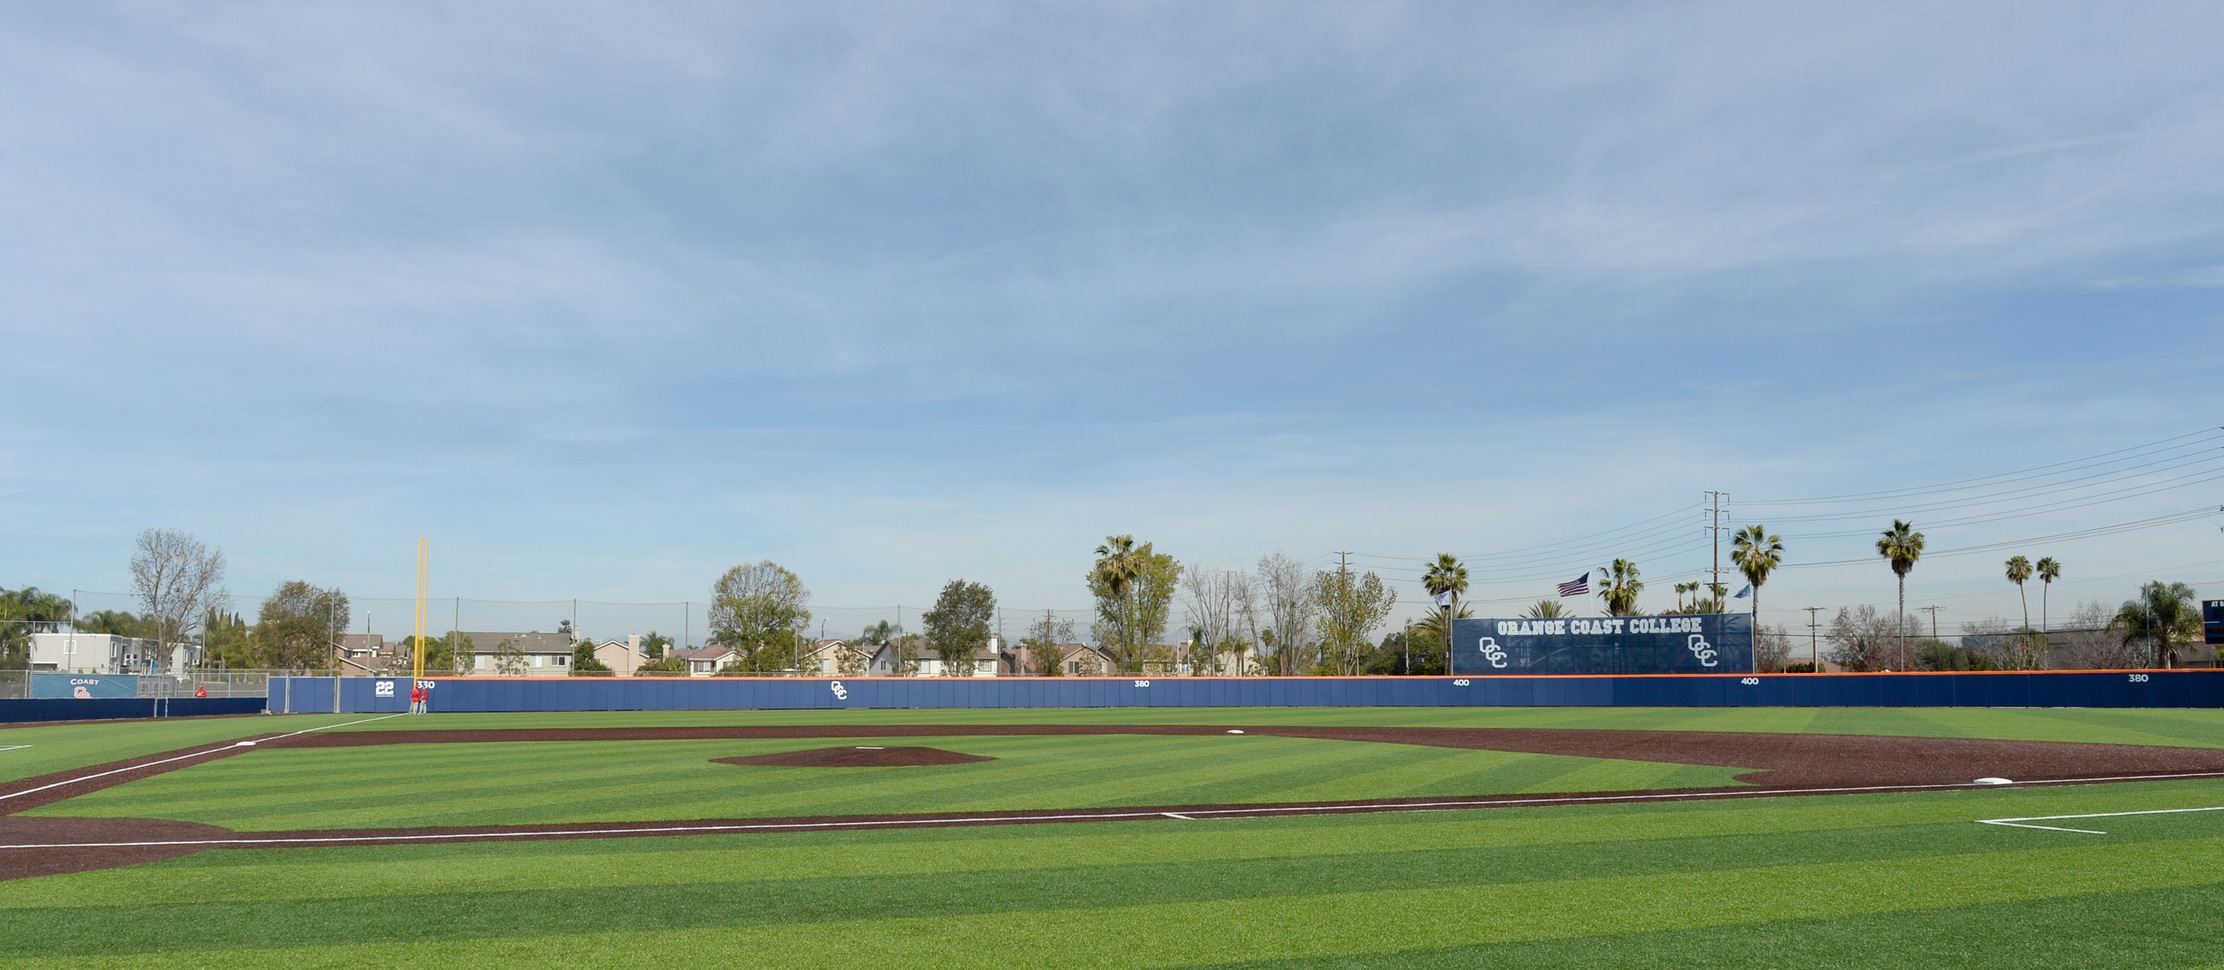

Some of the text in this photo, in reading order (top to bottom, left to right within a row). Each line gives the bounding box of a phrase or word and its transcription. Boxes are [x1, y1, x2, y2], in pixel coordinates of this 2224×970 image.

[1497, 617, 1702, 636] ORANGE COAST COLLEGE
[1479, 636, 1508, 668] OCC
[1687, 633, 1718, 667] OCC
[1134, 680, 1150, 688] 380
[1452, 678, 1470, 687] 400
[1740, 677, 1760, 686] 400
[2128, 673, 2149, 683] 380
[375, 680, 394, 695] 22
[416, 680, 435, 690] 330
[831, 680, 848, 700] OCC
